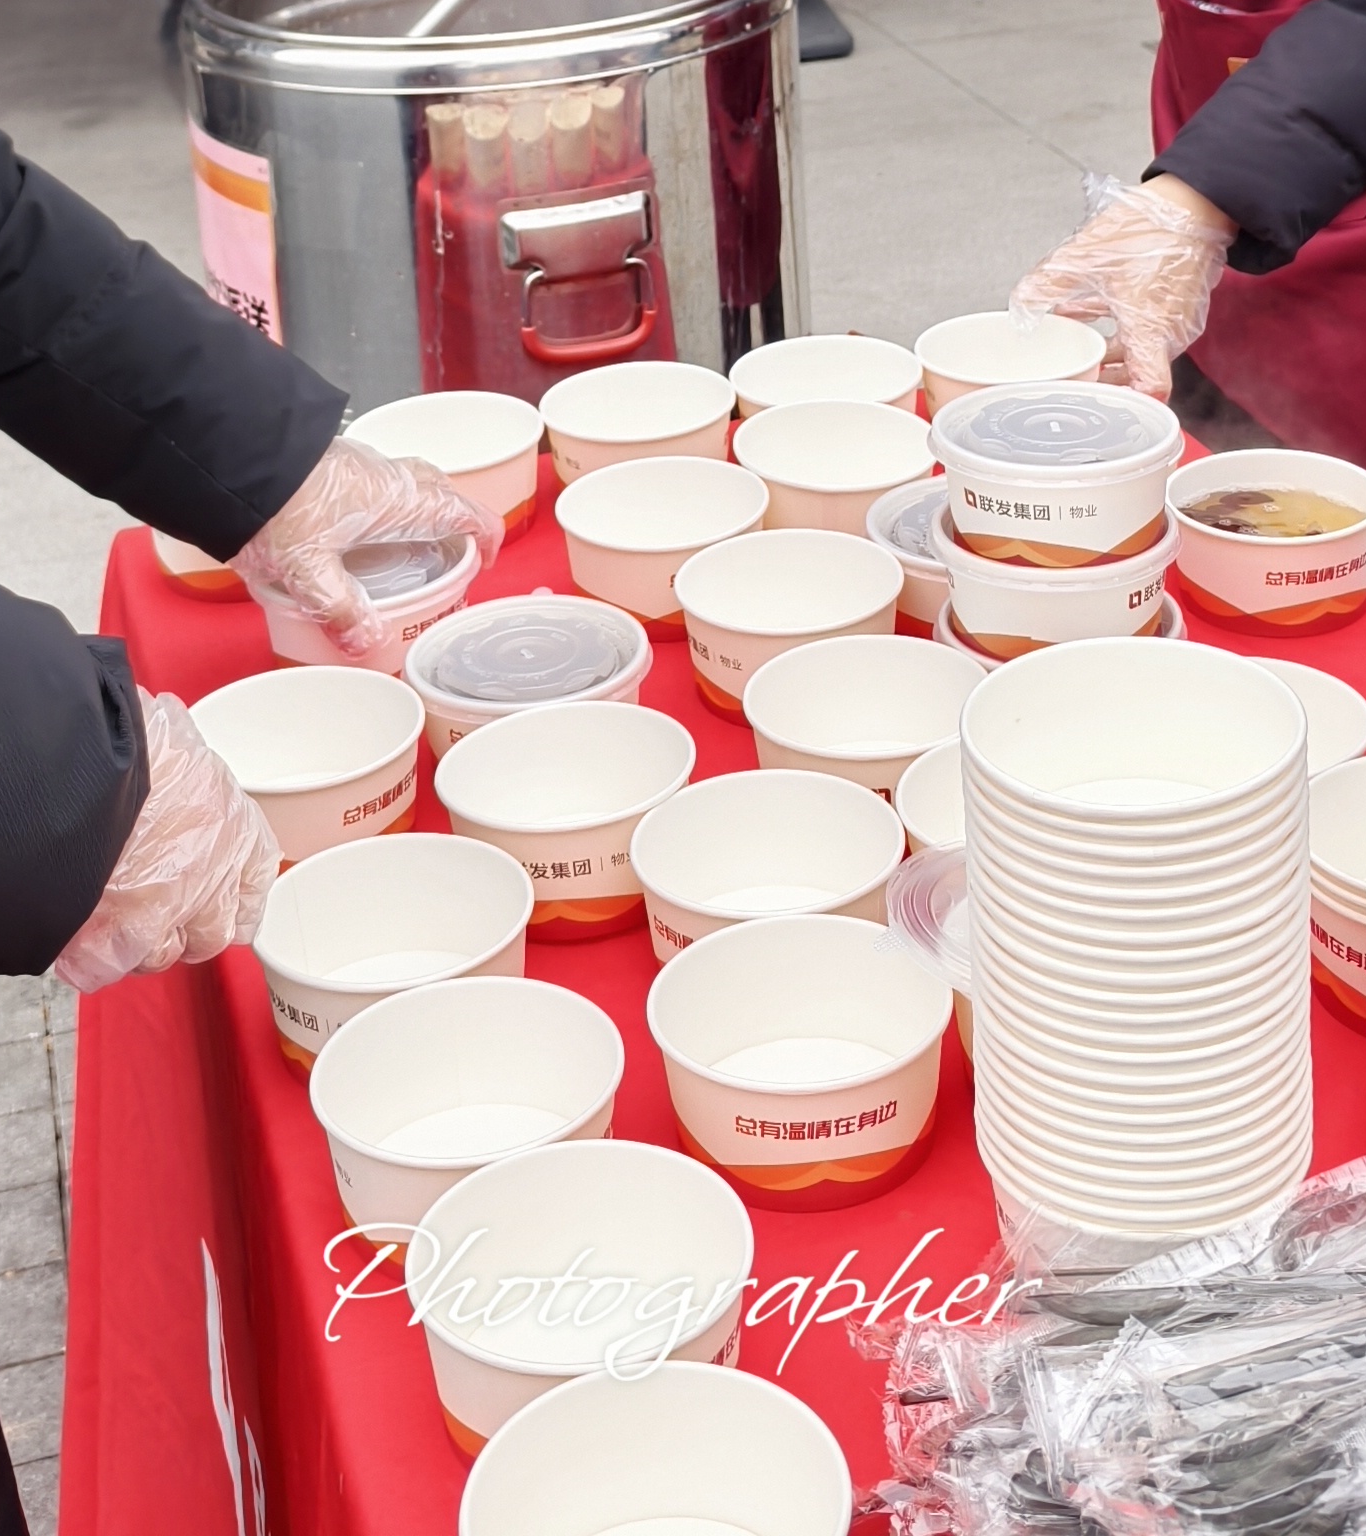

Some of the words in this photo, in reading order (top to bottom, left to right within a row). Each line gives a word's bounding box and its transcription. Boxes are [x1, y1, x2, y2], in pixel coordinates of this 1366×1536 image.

[978, 494, 1051, 522] 联发集团
[1069, 504, 1098, 520] 物业
[1143, 569, 1166, 602] 联发
[719, 654, 743, 671] 物业
[520, 858, 592, 880] 发集团
[610, 852, 631, 867] 物
[735, 1100, 898, 1141] 总有温情在身边
